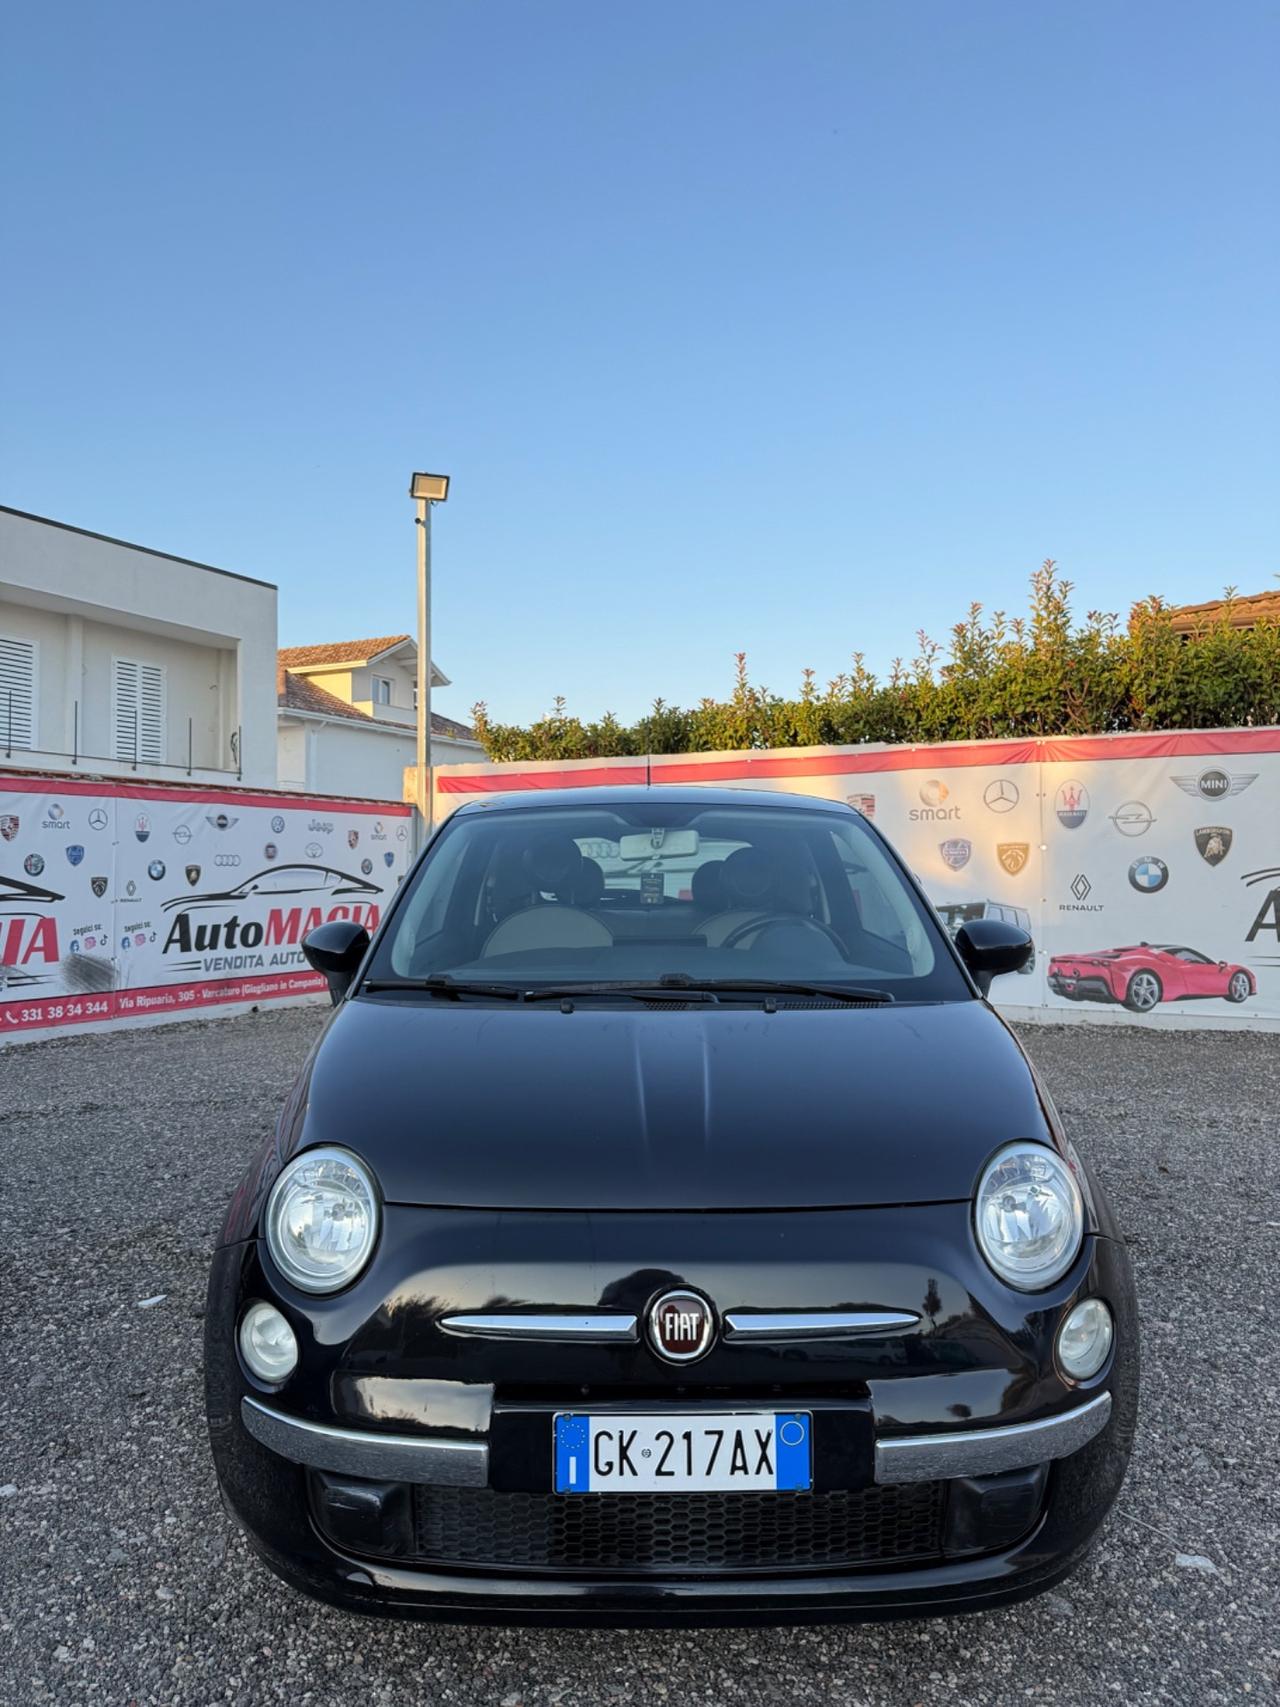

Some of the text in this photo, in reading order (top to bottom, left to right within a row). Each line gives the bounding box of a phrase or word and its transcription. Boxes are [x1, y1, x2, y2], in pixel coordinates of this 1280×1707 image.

[1200, 779, 1228, 789] MINI
[909, 806, 961, 821] smart
[41, 820, 71, 830] smart
[1059, 904, 1104, 912] RENAULT
[0, 917, 60, 966] IA
[203, 955, 264, 972] VENDITA
[119, 997, 134, 1009] Via
[178, 990, 195, 1003] 305
[21, 1000, 108, 1022] 331 38 34 344
[663, 1312, 700, 1341] FIAT
